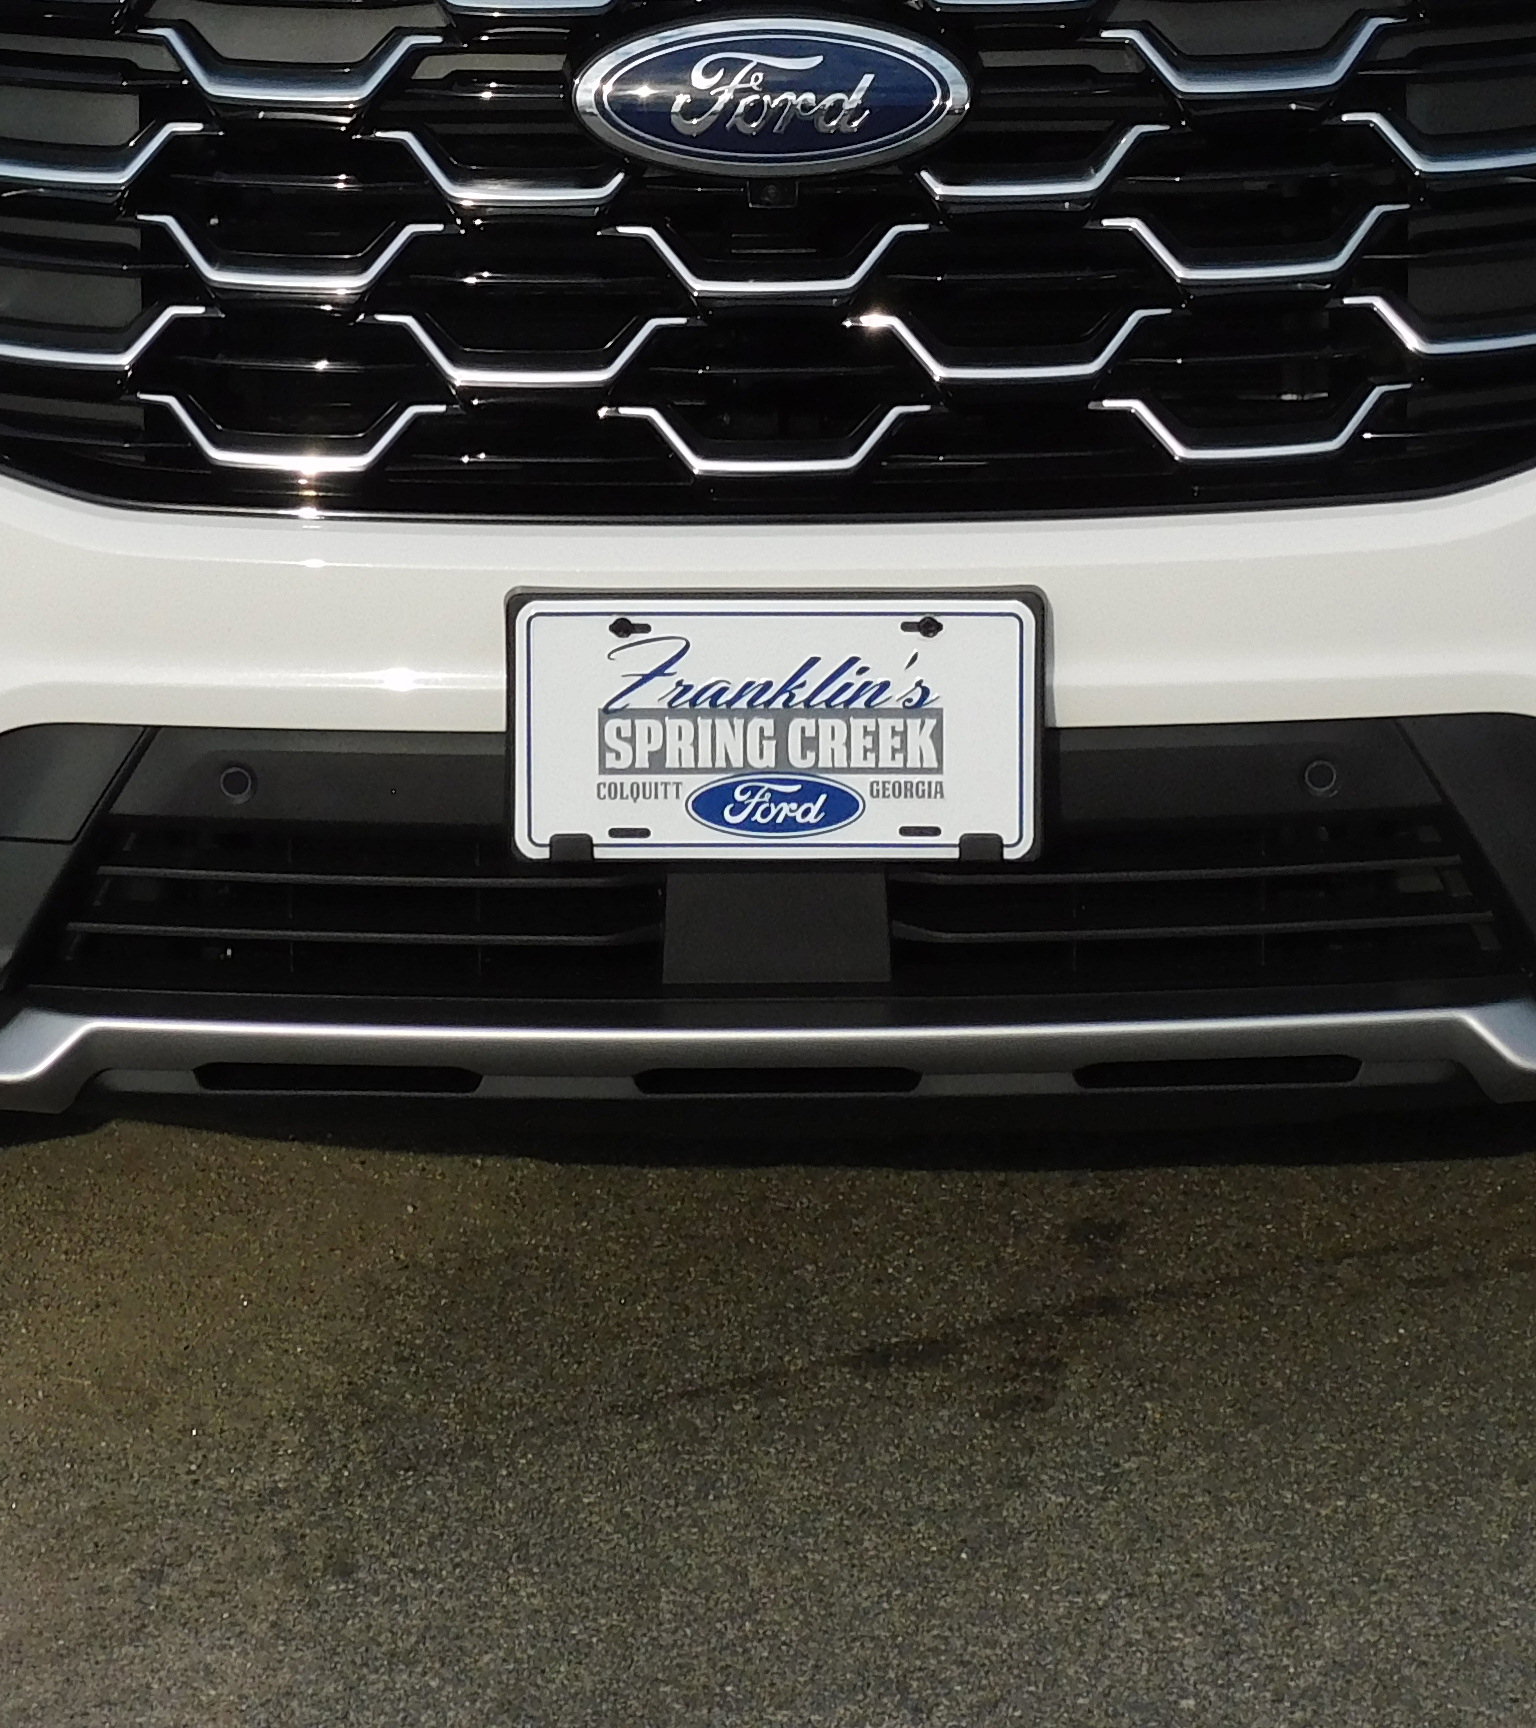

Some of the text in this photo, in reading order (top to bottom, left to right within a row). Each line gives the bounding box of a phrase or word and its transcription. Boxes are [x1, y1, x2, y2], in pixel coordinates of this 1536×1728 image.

[670, 51, 875, 136] Ford
[601, 635, 941, 715] Franklin's
[603, 715, 940, 770] SPRING CREEK
[596, 780, 683, 803] COLQUITT
[723, 782, 826, 825] Ford
[868, 779, 945, 801] GEORGIA
